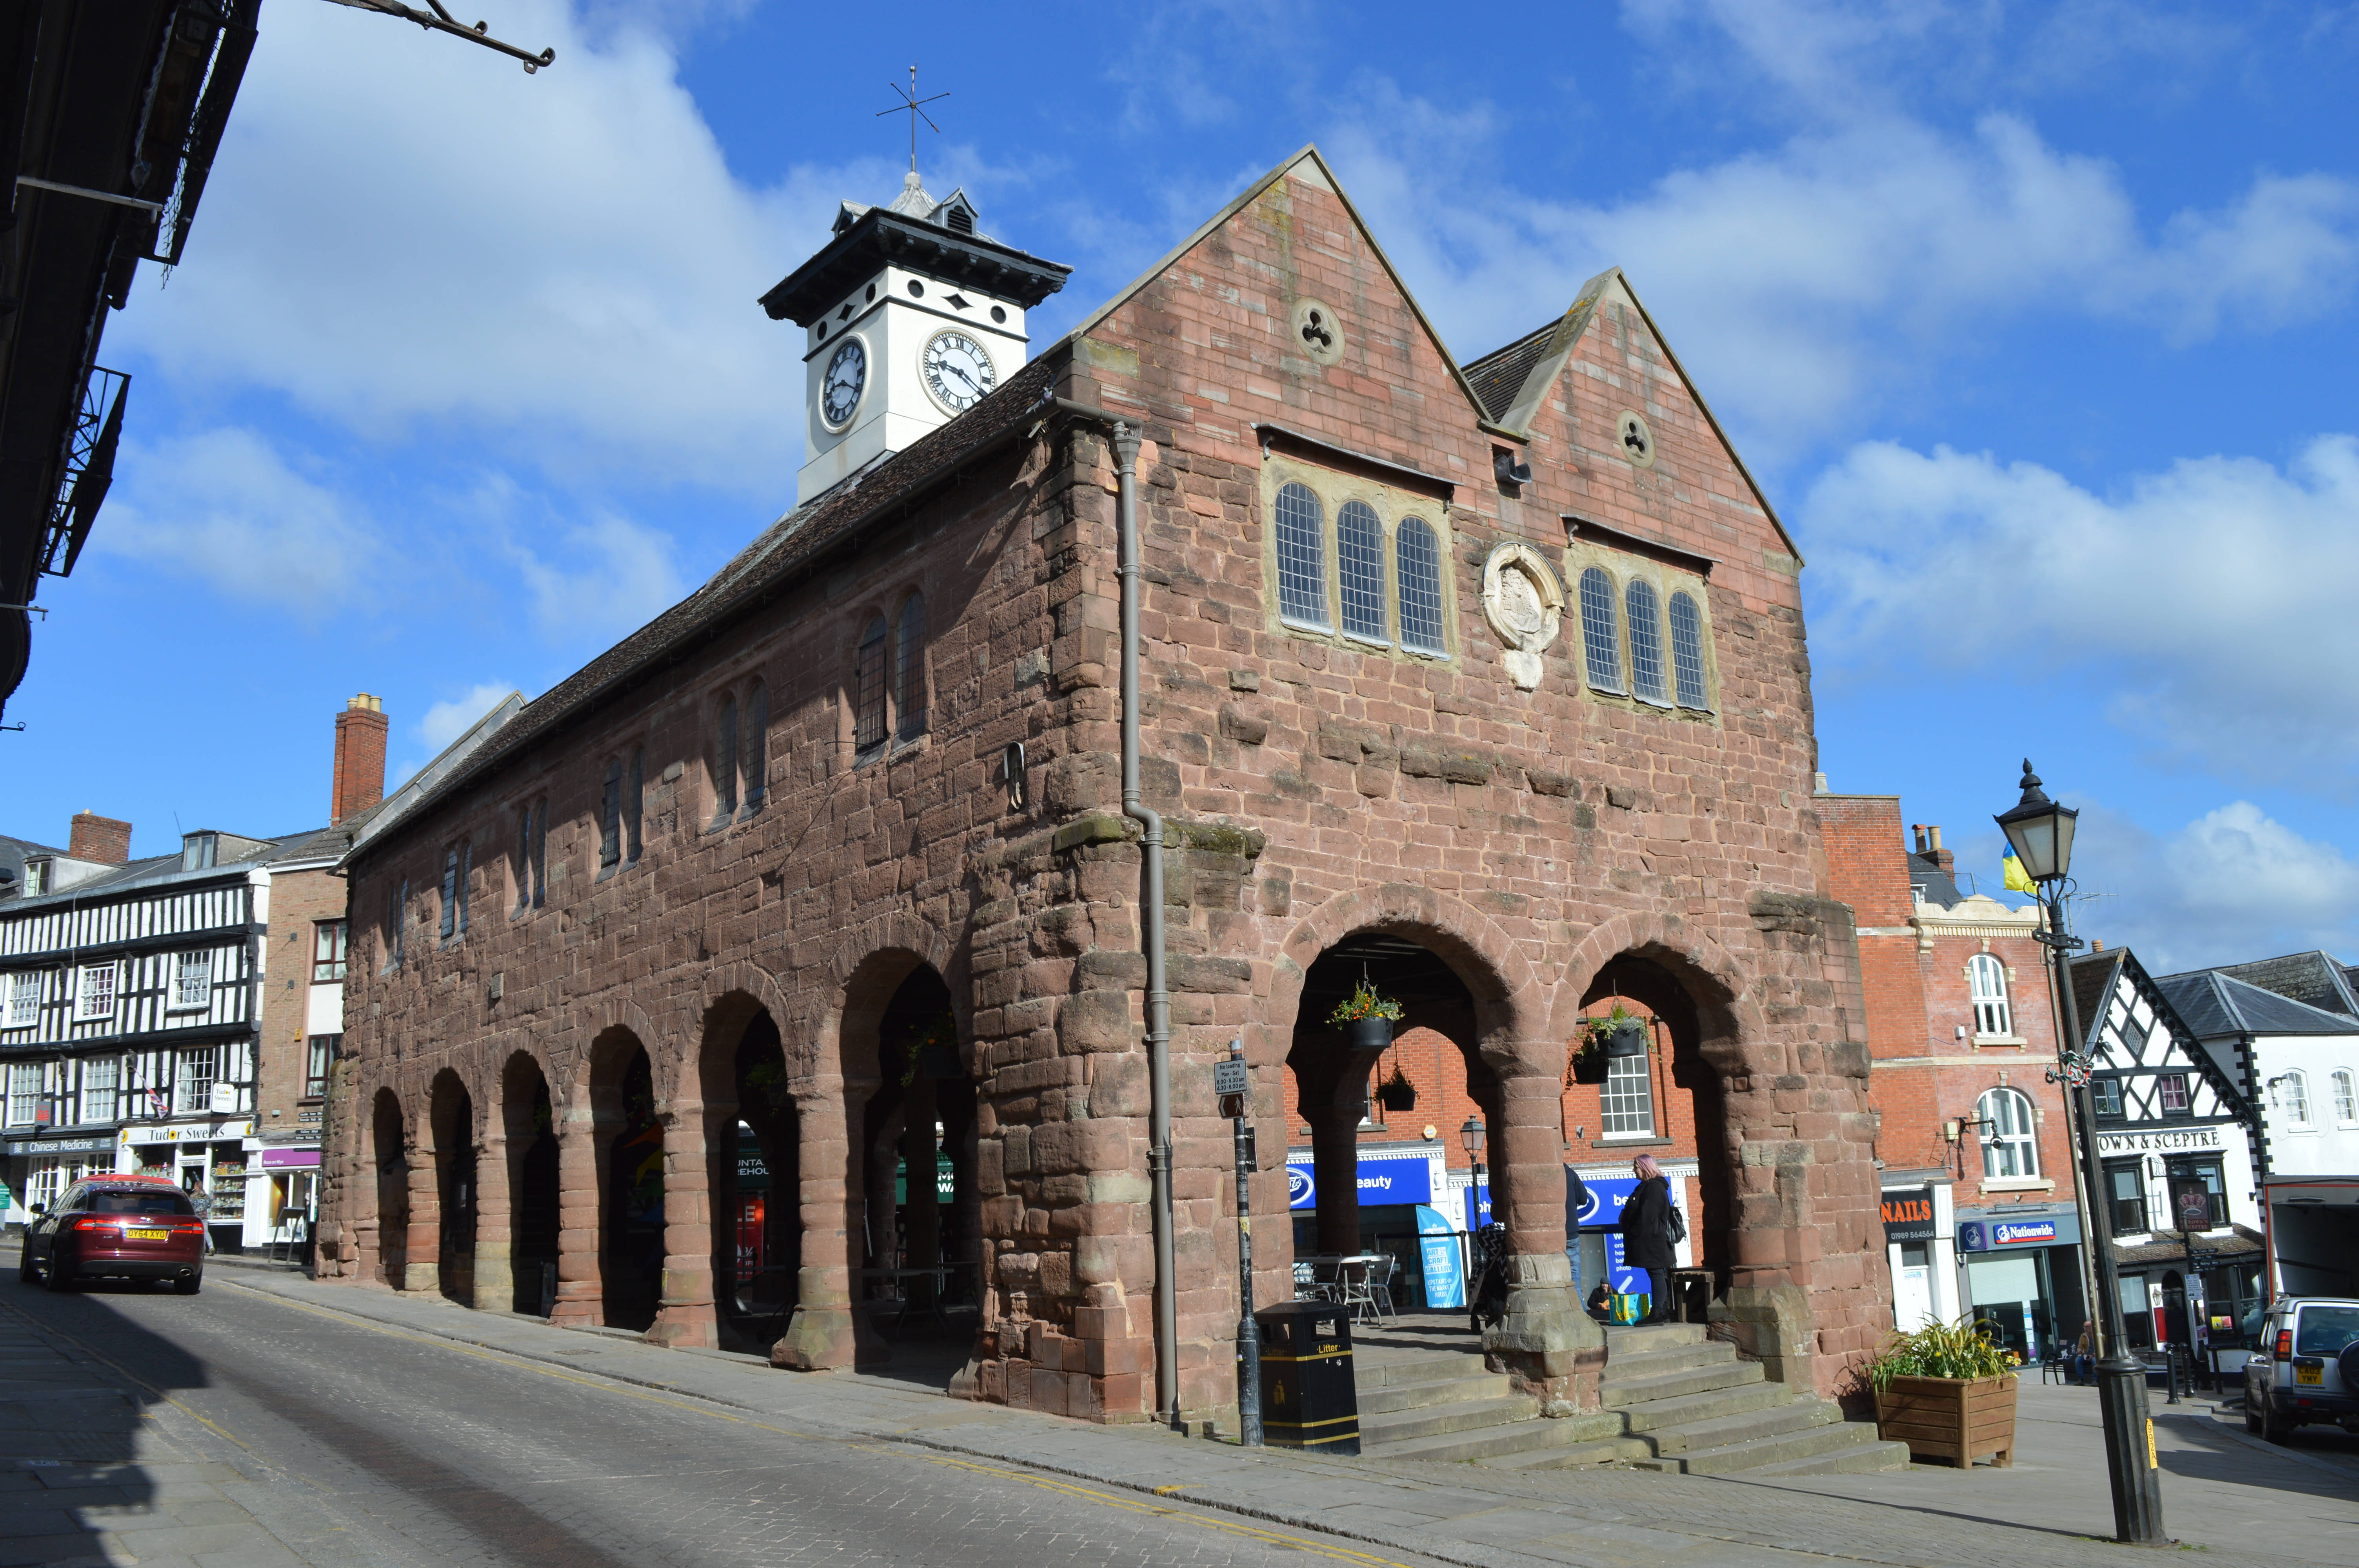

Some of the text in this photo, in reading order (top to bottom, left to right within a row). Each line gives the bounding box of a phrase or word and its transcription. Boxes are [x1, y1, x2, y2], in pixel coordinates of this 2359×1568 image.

[149, 1127, 225, 1141] Tudor Sweets
[2141, 1135, 2149, 1149] &
[2154, 1131, 2220, 1148] SCEPTRE
[29, 1141, 58, 1152] Chinese
[60, 1140, 93, 1151] Medicine
[1357, 1175, 1392, 1189] eauty
[1881, 1200, 1931, 1223] NAILS
[1910, 1230, 1934, 1238] 564564
[2009, 1224, 2054, 1238] Nationwide
[1426, 1265, 1452, 1273] GALLERY
[1318, 1344, 1338, 1354] Litter
